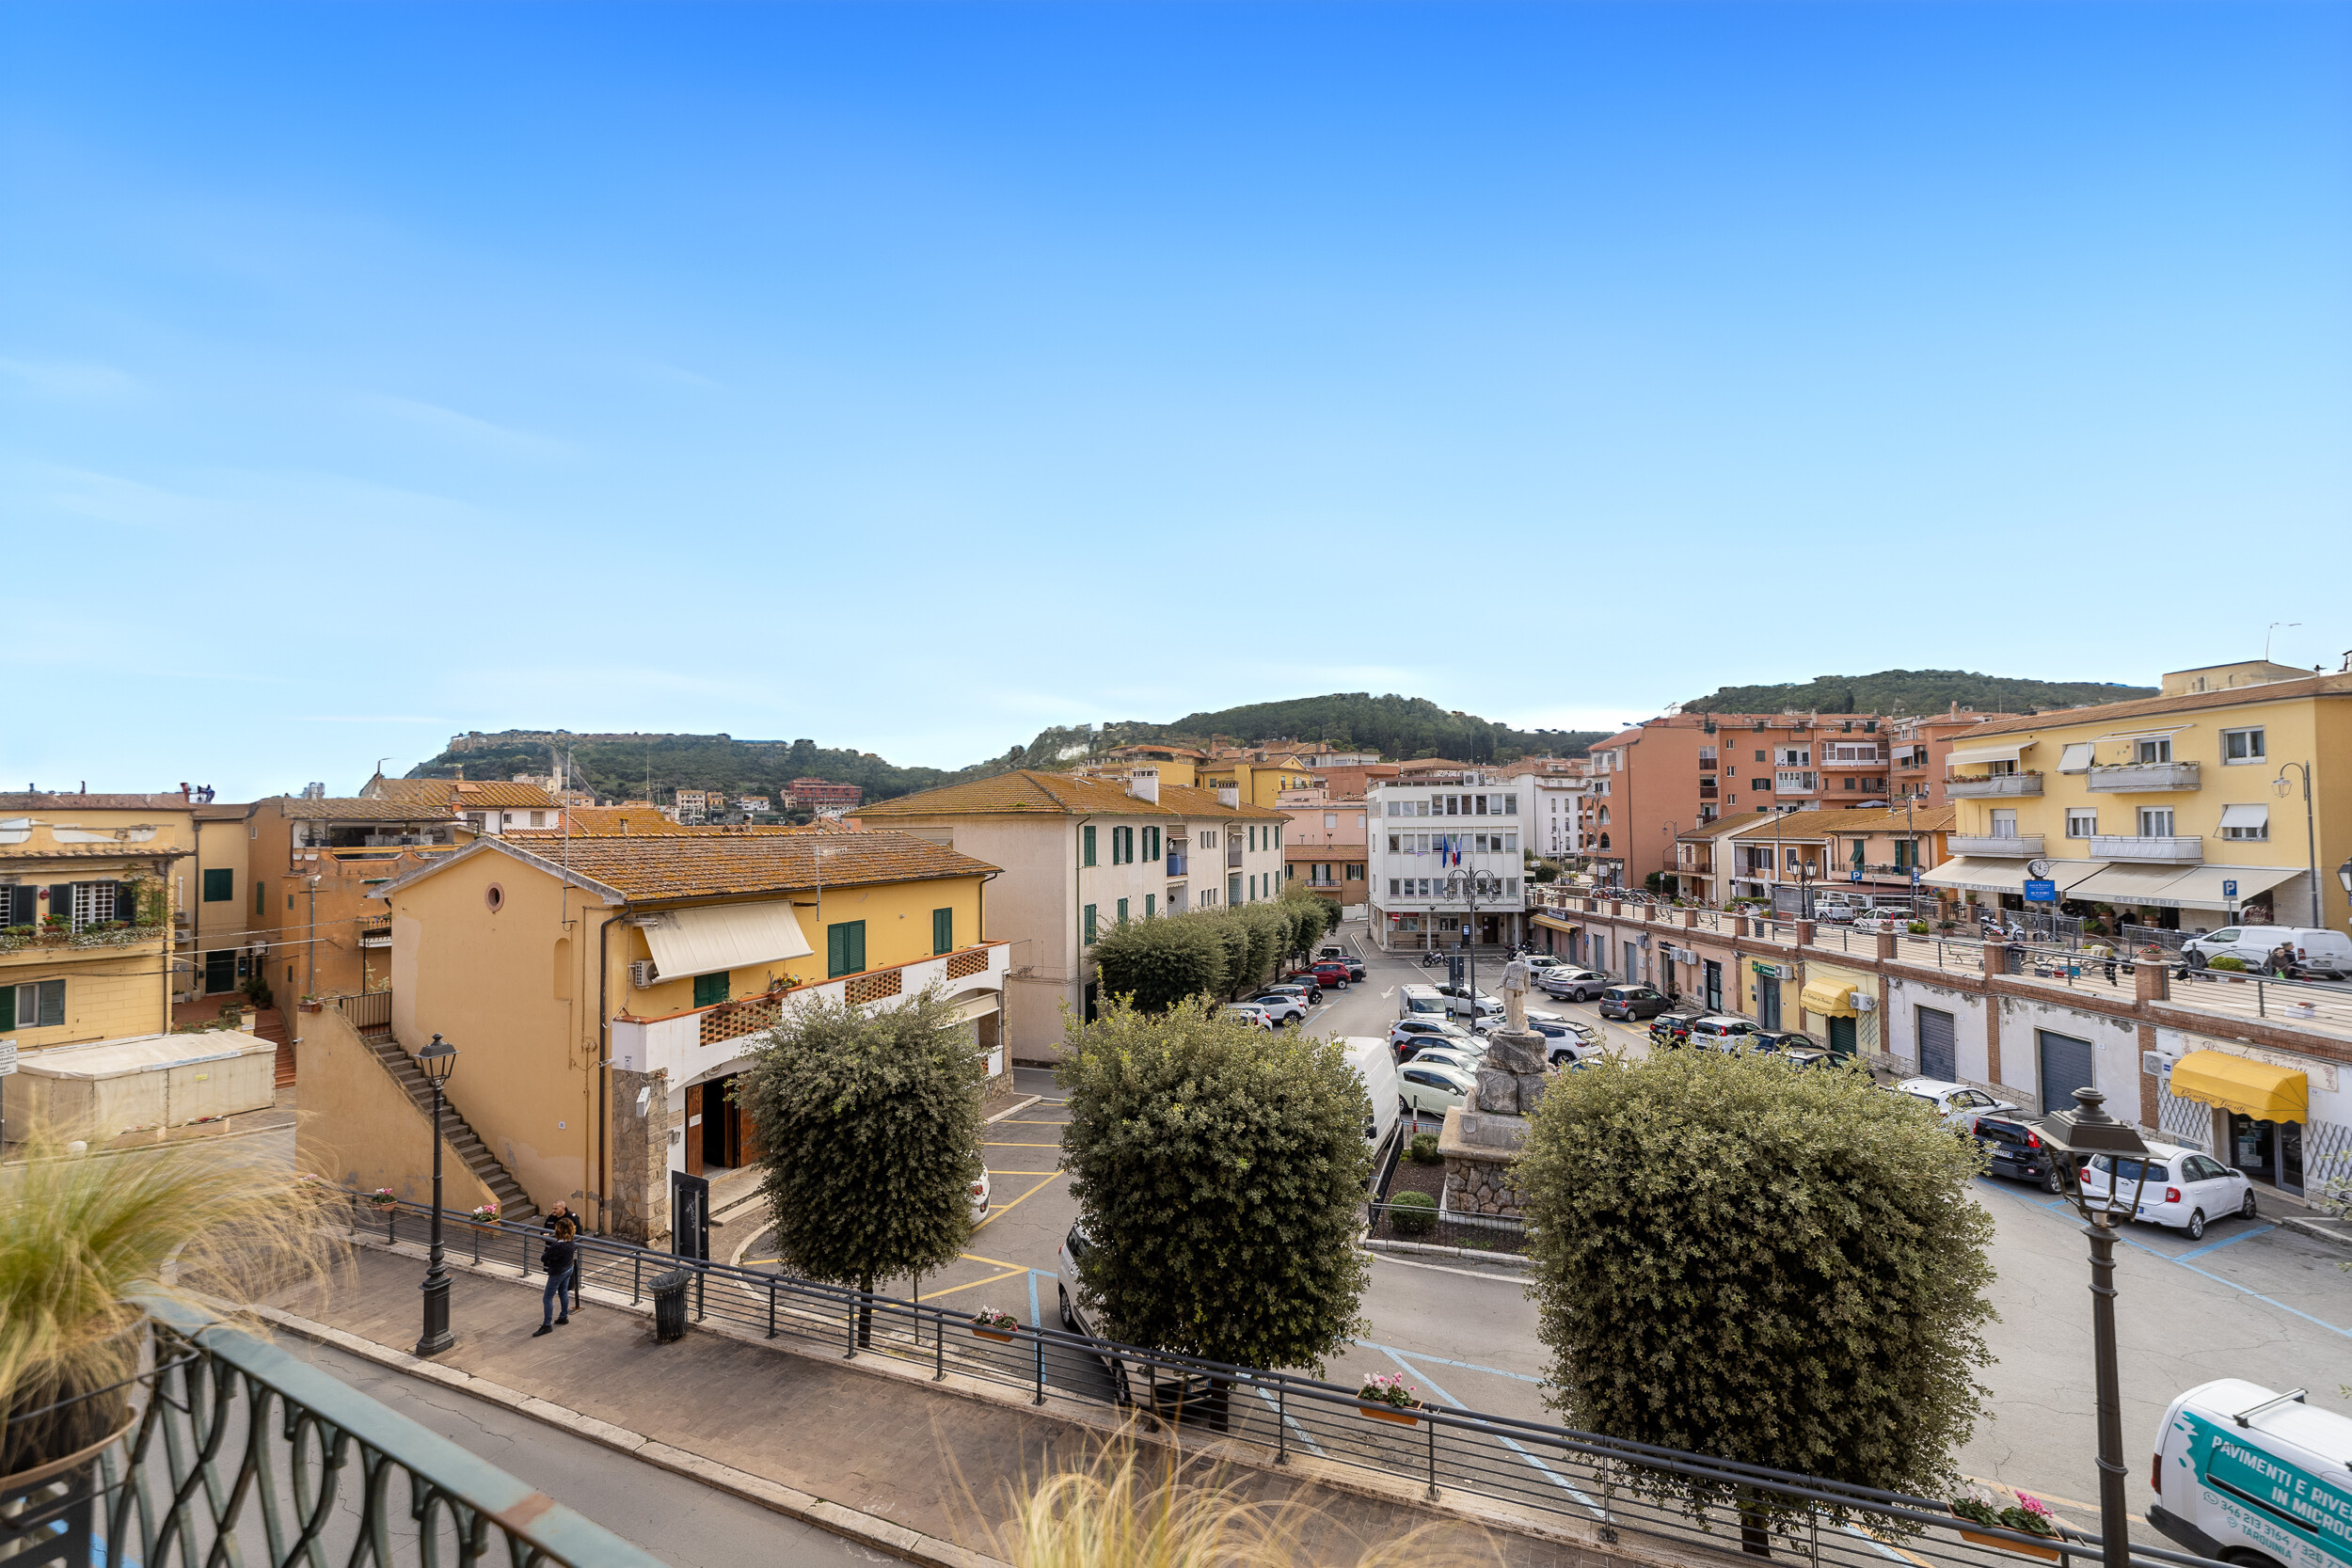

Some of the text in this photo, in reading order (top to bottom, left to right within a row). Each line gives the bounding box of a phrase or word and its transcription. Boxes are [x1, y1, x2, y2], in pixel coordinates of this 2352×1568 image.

[1852, 871, 1861, 879] P
[1971, 884, 2014, 894] CENTRALE
[2225, 881, 2235, 893] P
[2114, 895, 2181, 907] GELATERIA
[1761, 967, 1776, 975] Groupa
[2211, 1434, 2292, 1487] PAVIMENTI
[2295, 1479, 2308, 1496] E
[2271, 1486, 2352, 1543] IN MICROC
[2220, 1500, 2240, 1518] 346
[2243, 1513, 2261, 1529] 213
[2264, 1524, 2290, 1544] 3164
[2300, 1544, 2323, 1563] 320
[2241, 1524, 2293, 1560] TARQUINIA
